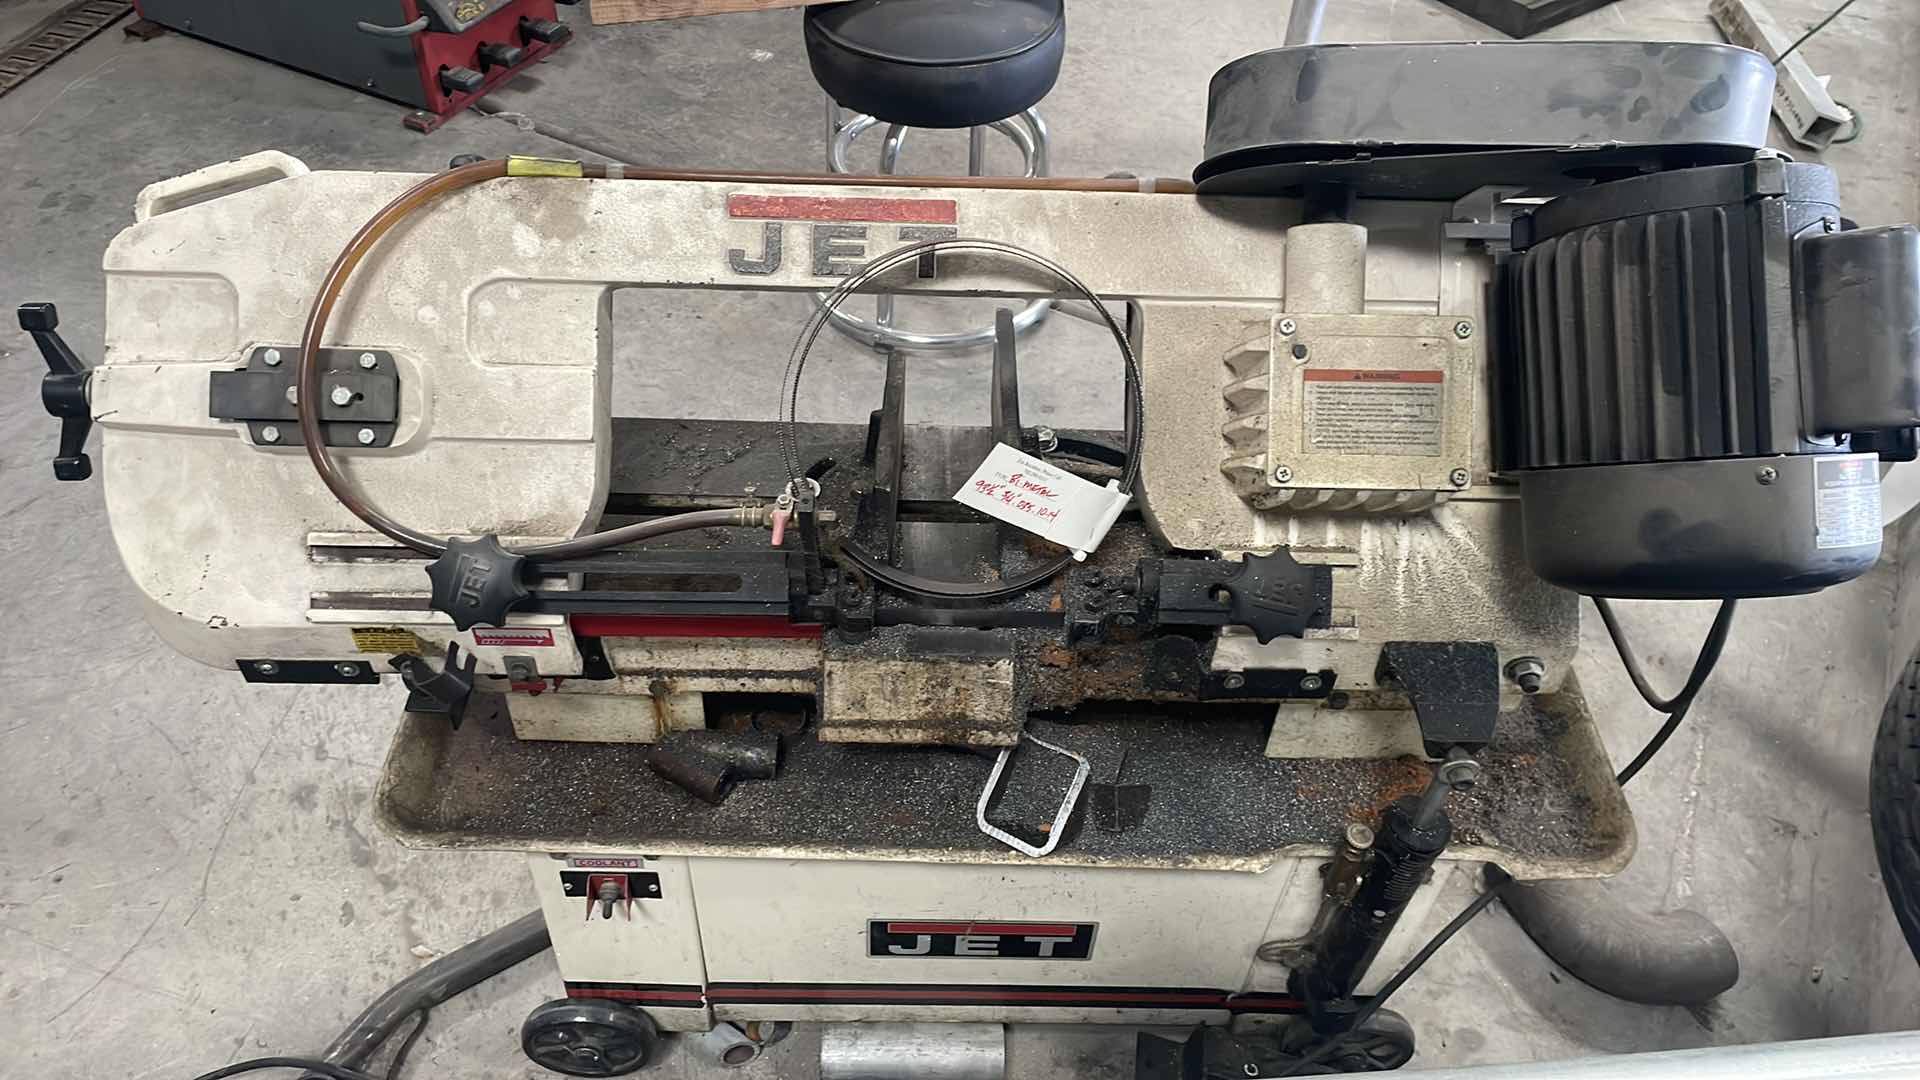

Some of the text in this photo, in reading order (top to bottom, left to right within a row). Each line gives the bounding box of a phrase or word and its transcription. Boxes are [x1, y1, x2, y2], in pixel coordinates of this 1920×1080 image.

[728, 222, 958, 279] JET
[460, 557, 493, 609] JET
[887, 934, 1073, 957] JET
